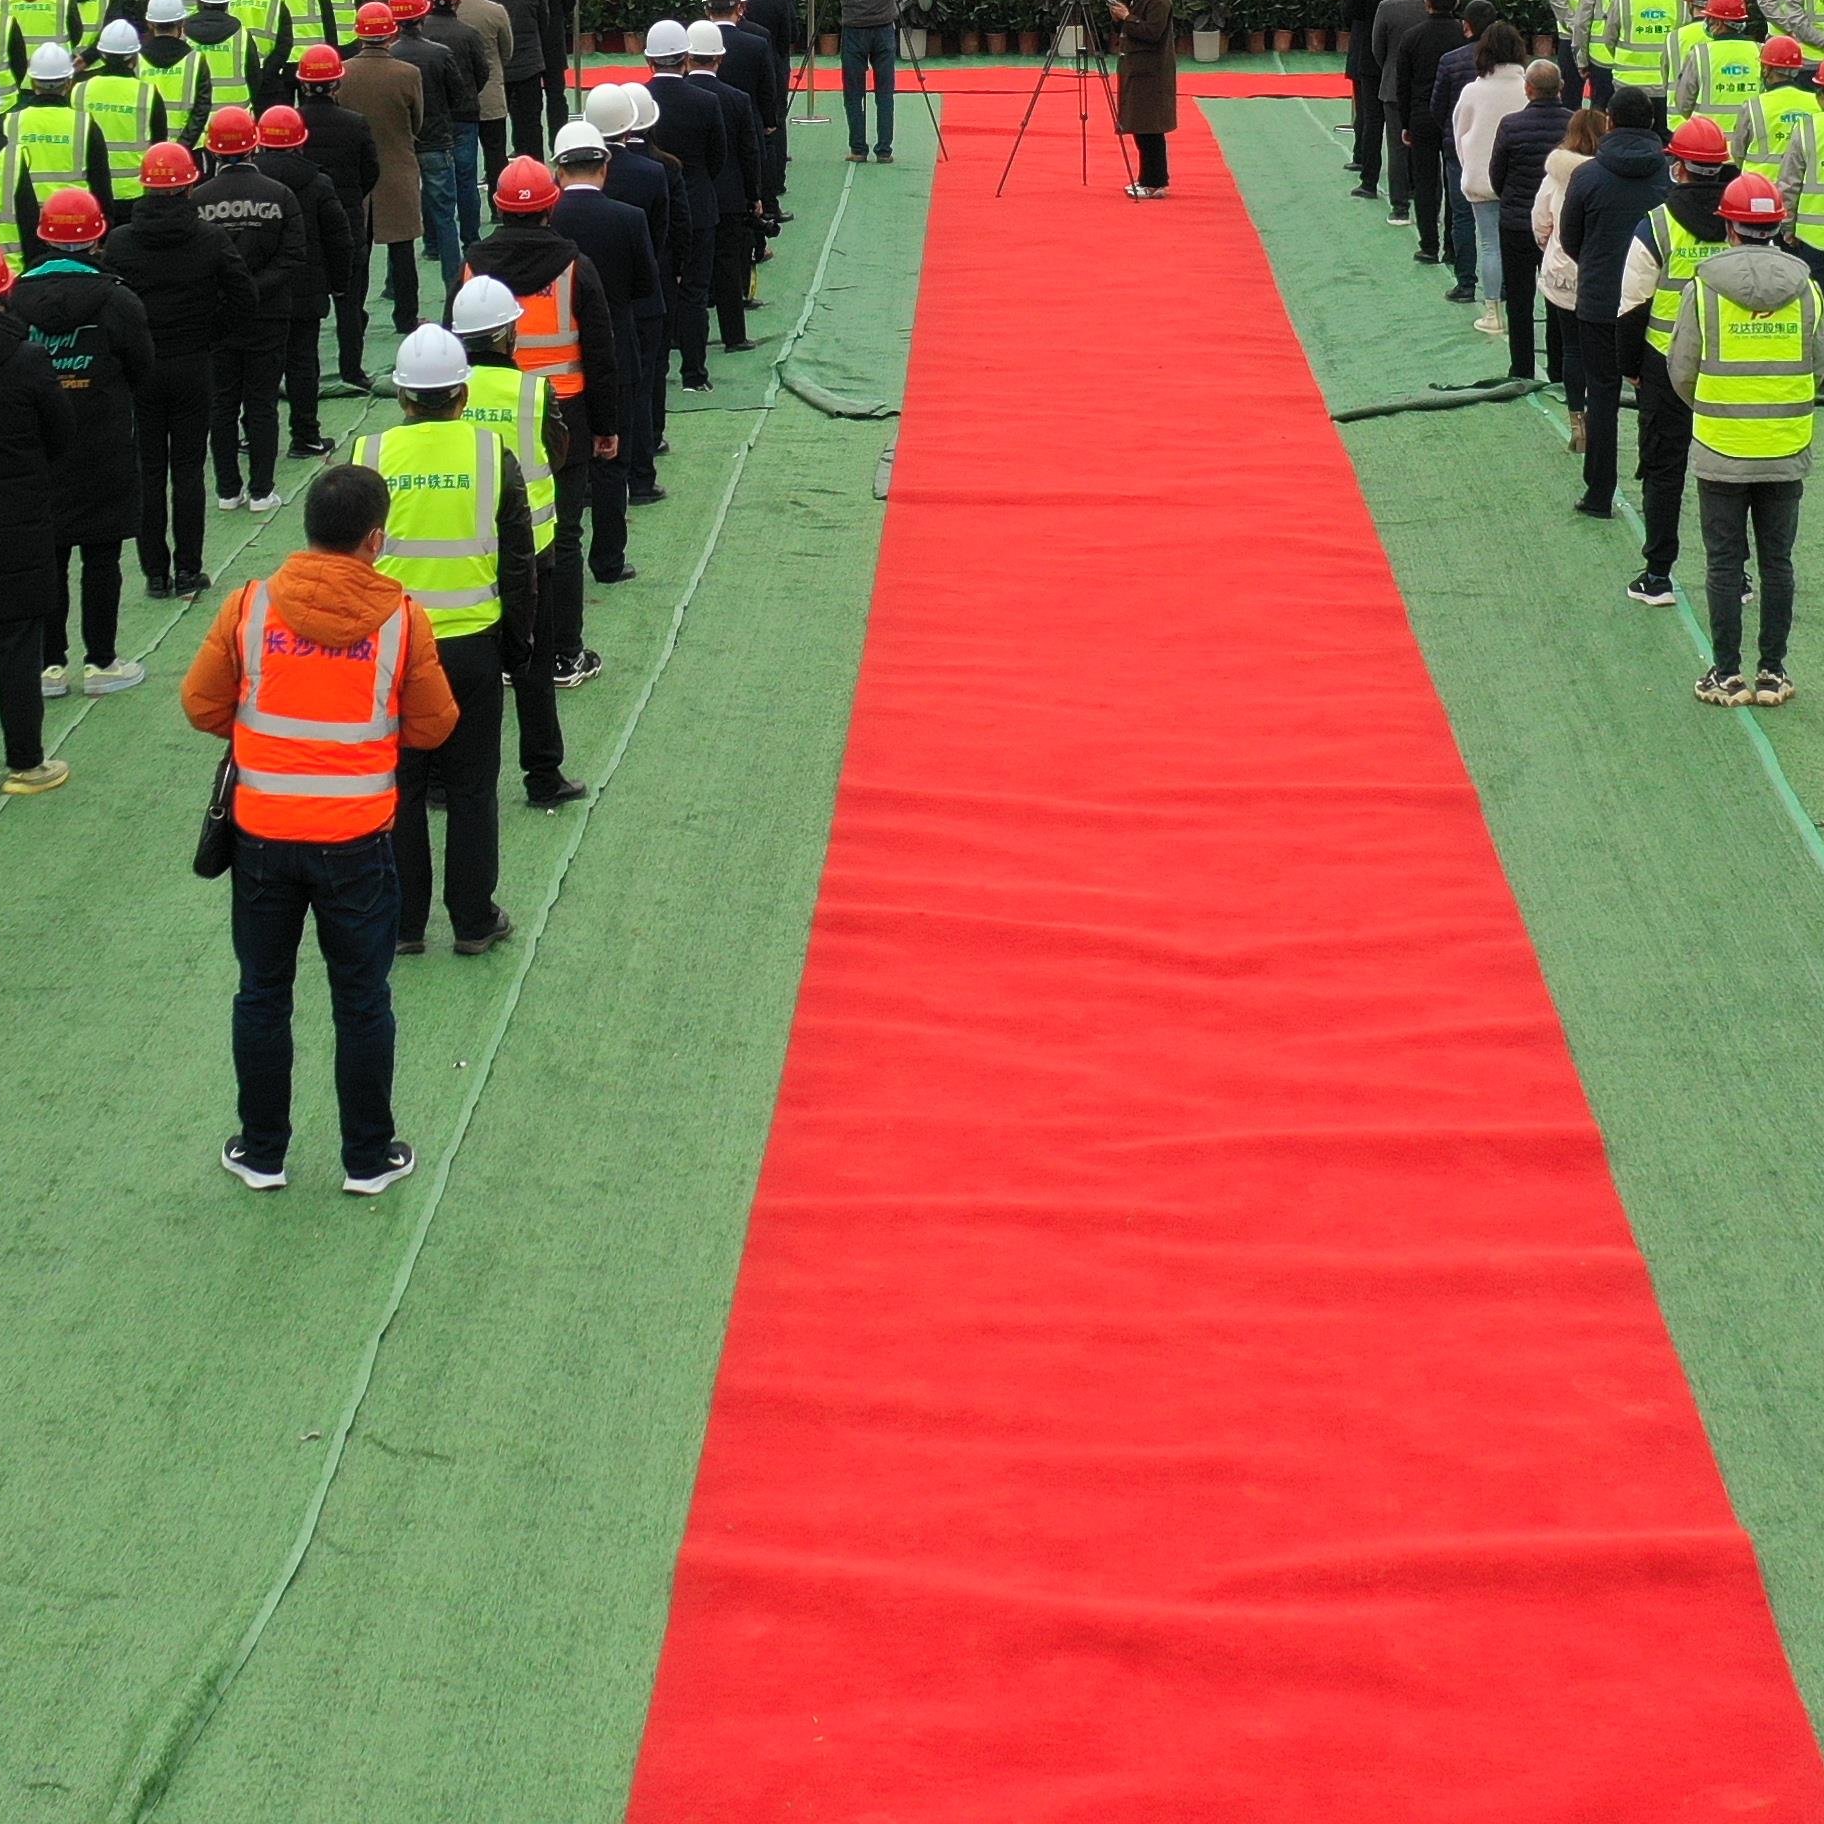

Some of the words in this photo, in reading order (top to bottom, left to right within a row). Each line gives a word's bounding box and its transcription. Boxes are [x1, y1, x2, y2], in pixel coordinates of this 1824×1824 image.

[1721, 65, 1751, 76] MCC
[1715, 82, 1757, 92] 中冶建工
[518, 189, 531, 200] 29
[1728, 322, 1798, 334] 发达控股集团
[463, 407, 513, 423] 中铁五局
[385, 473, 471, 490] 中国中铁五局
